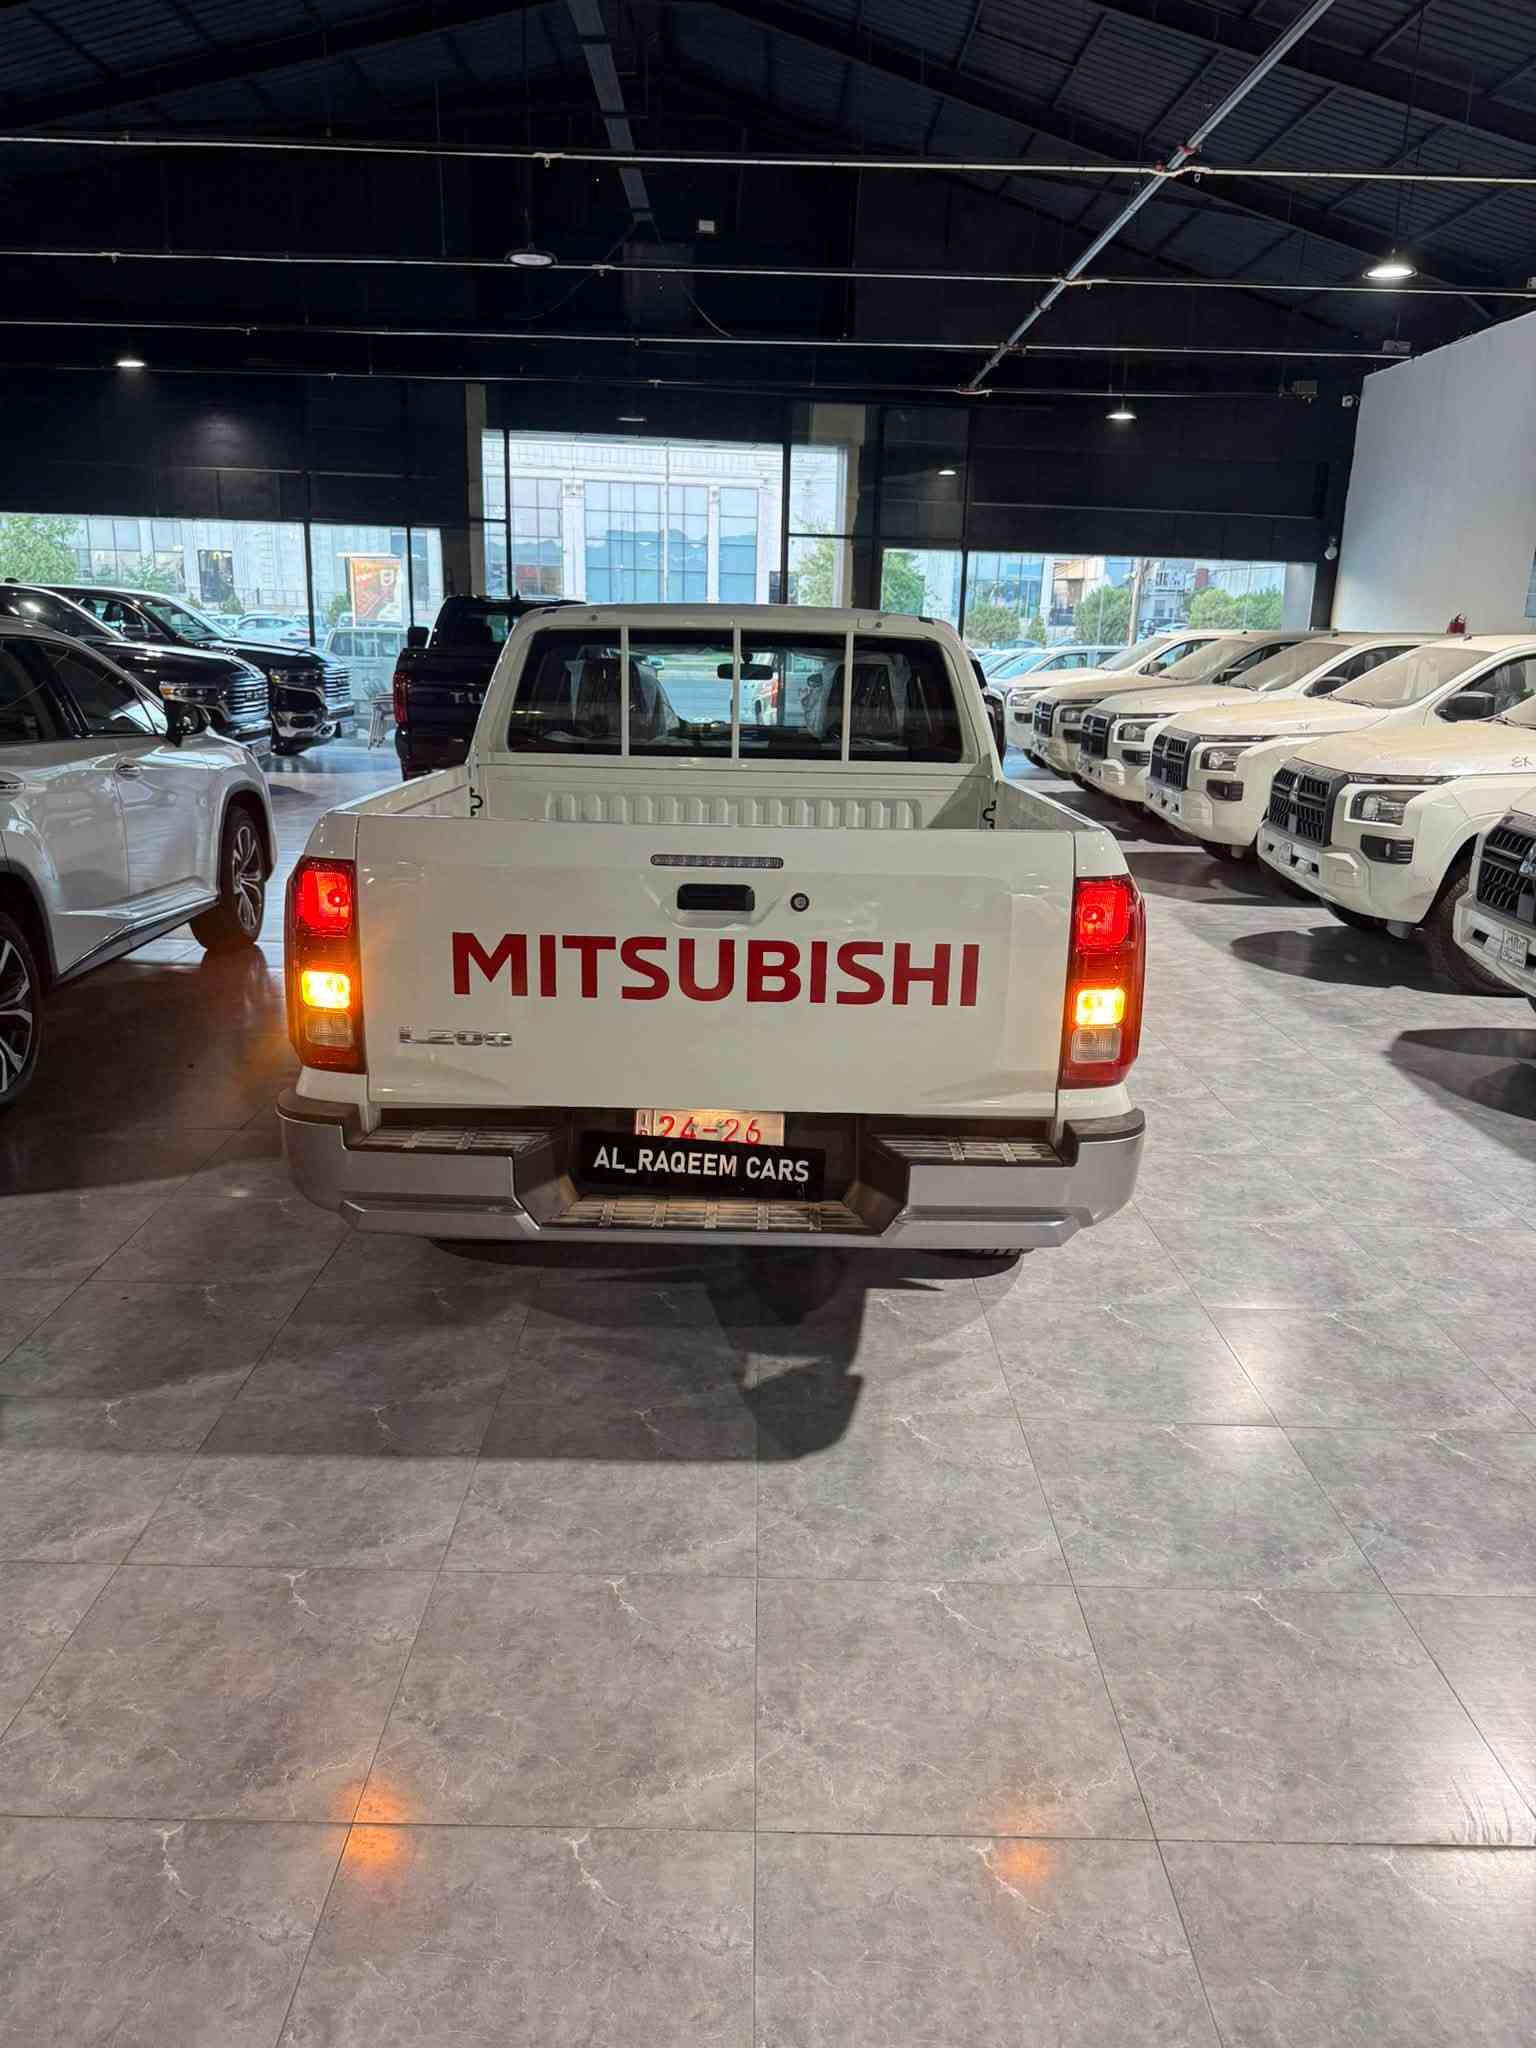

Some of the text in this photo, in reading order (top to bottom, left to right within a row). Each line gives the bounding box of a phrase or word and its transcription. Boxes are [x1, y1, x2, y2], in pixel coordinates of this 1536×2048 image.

[452, 932, 980, 1007] MITSUBISHI
[399, 1025, 513, 1047] L200
[593, 1146, 809, 1182] AL_RAQEEM CARS
